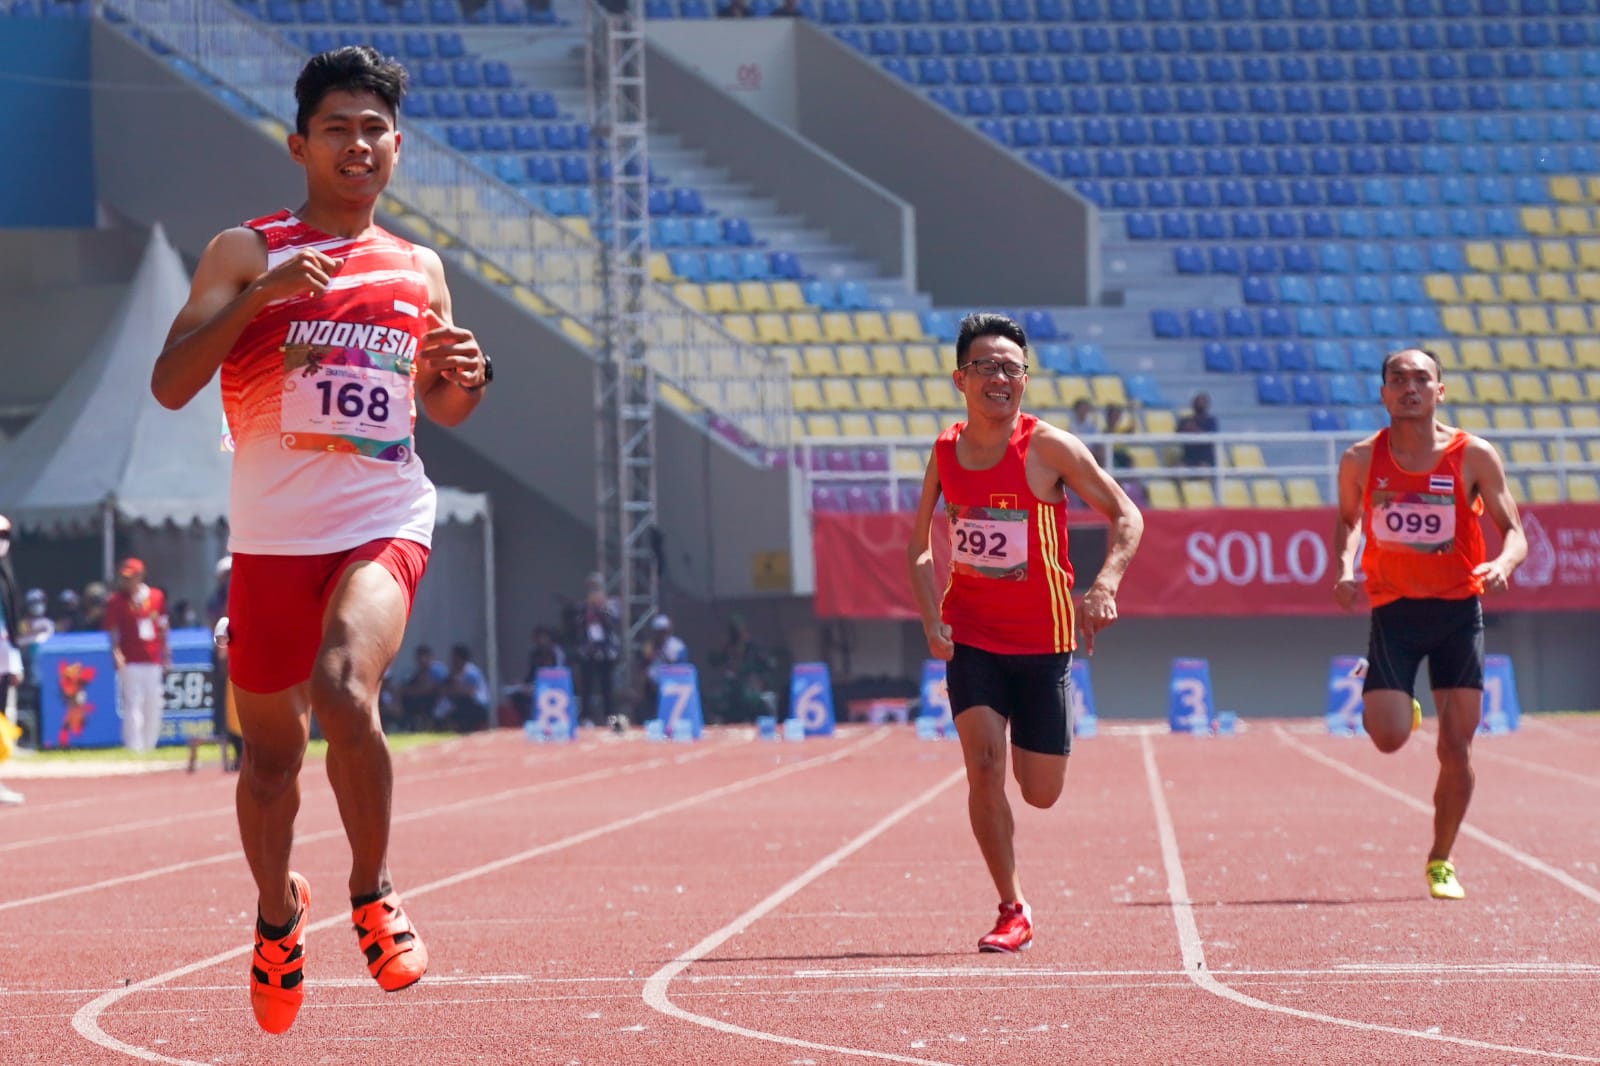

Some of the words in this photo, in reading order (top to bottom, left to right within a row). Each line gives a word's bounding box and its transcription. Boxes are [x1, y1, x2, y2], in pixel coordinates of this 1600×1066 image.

[284, 320, 418, 361] INDONESIA
[316, 380, 389, 422] 168
[955, 528, 1008, 558] 292
[1385, 511, 1441, 534] 099
[1185, 529, 1328, 586] SOLO
[537, 688, 569, 728] 8
[662, 683, 693, 729] 7
[795, 683, 826, 730] 6
[927, 678, 954, 728] 5
[1176, 678, 1208, 726] 3
[1332, 677, 1363, 722] 2
[1484, 676, 1502, 718] 1
